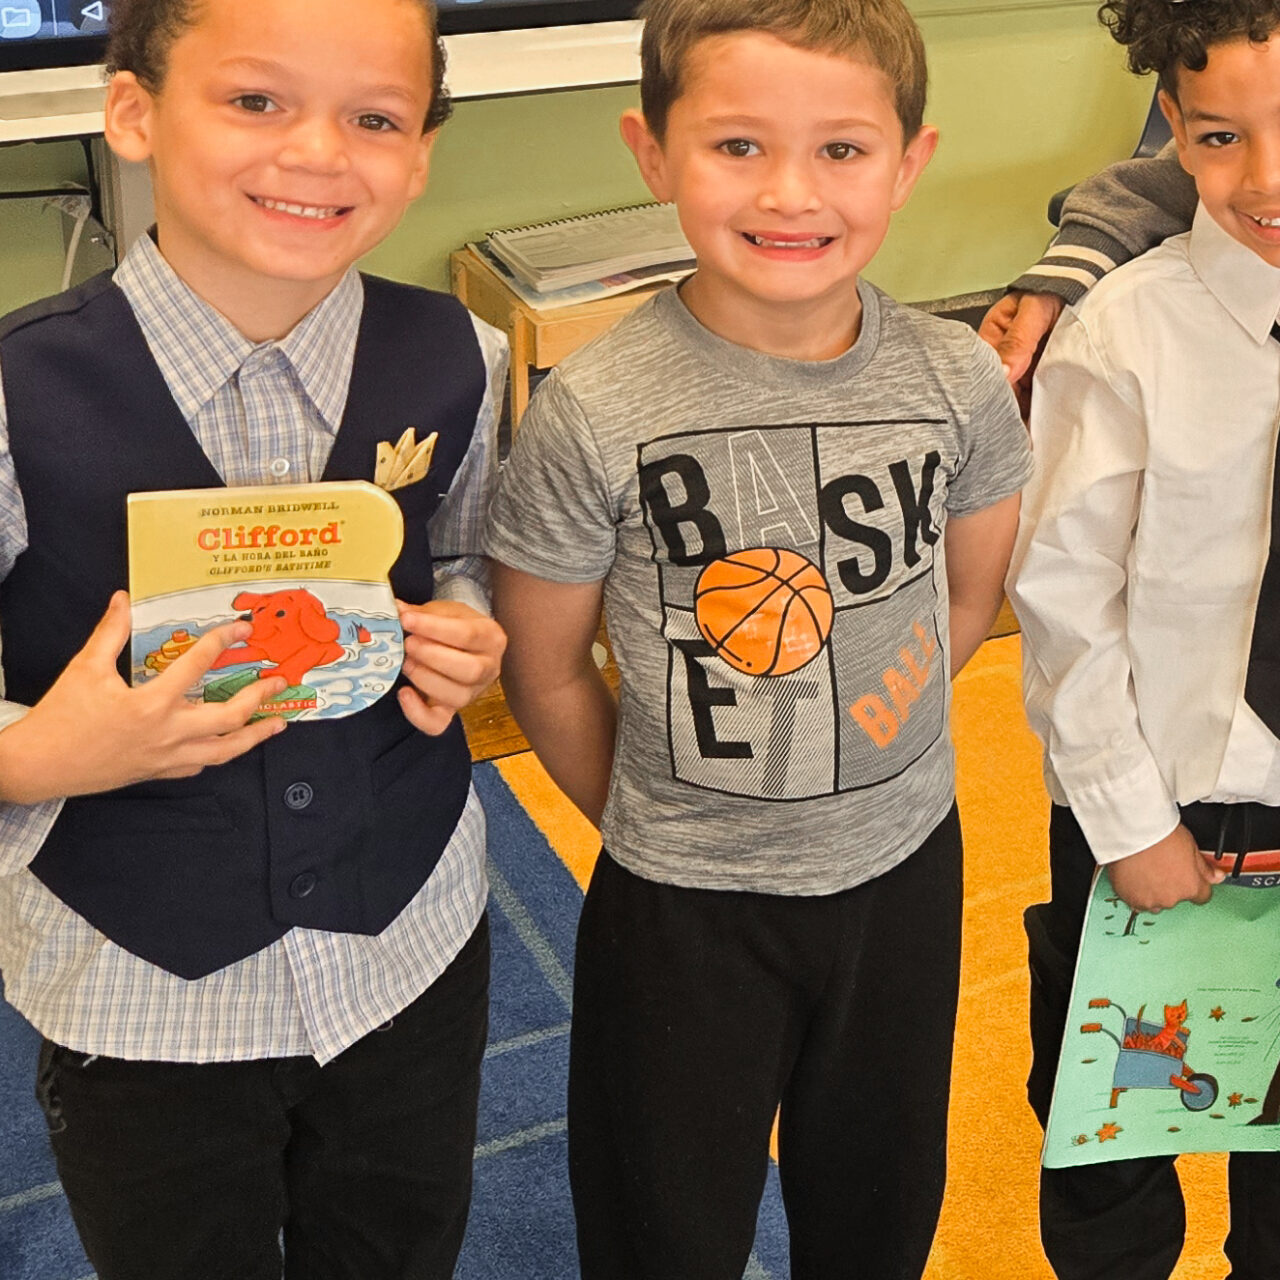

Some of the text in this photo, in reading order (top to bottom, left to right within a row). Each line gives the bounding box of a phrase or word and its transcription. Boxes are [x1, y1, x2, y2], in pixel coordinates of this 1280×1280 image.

[200, 501, 340, 517] NORMAN BRIDWELL
[197, 521, 342, 551] Clifford
[212, 546, 329, 562] Y LA HORA DEL BAÑO
[209, 560, 332, 576] CLIFFORD'S BATHTIME
